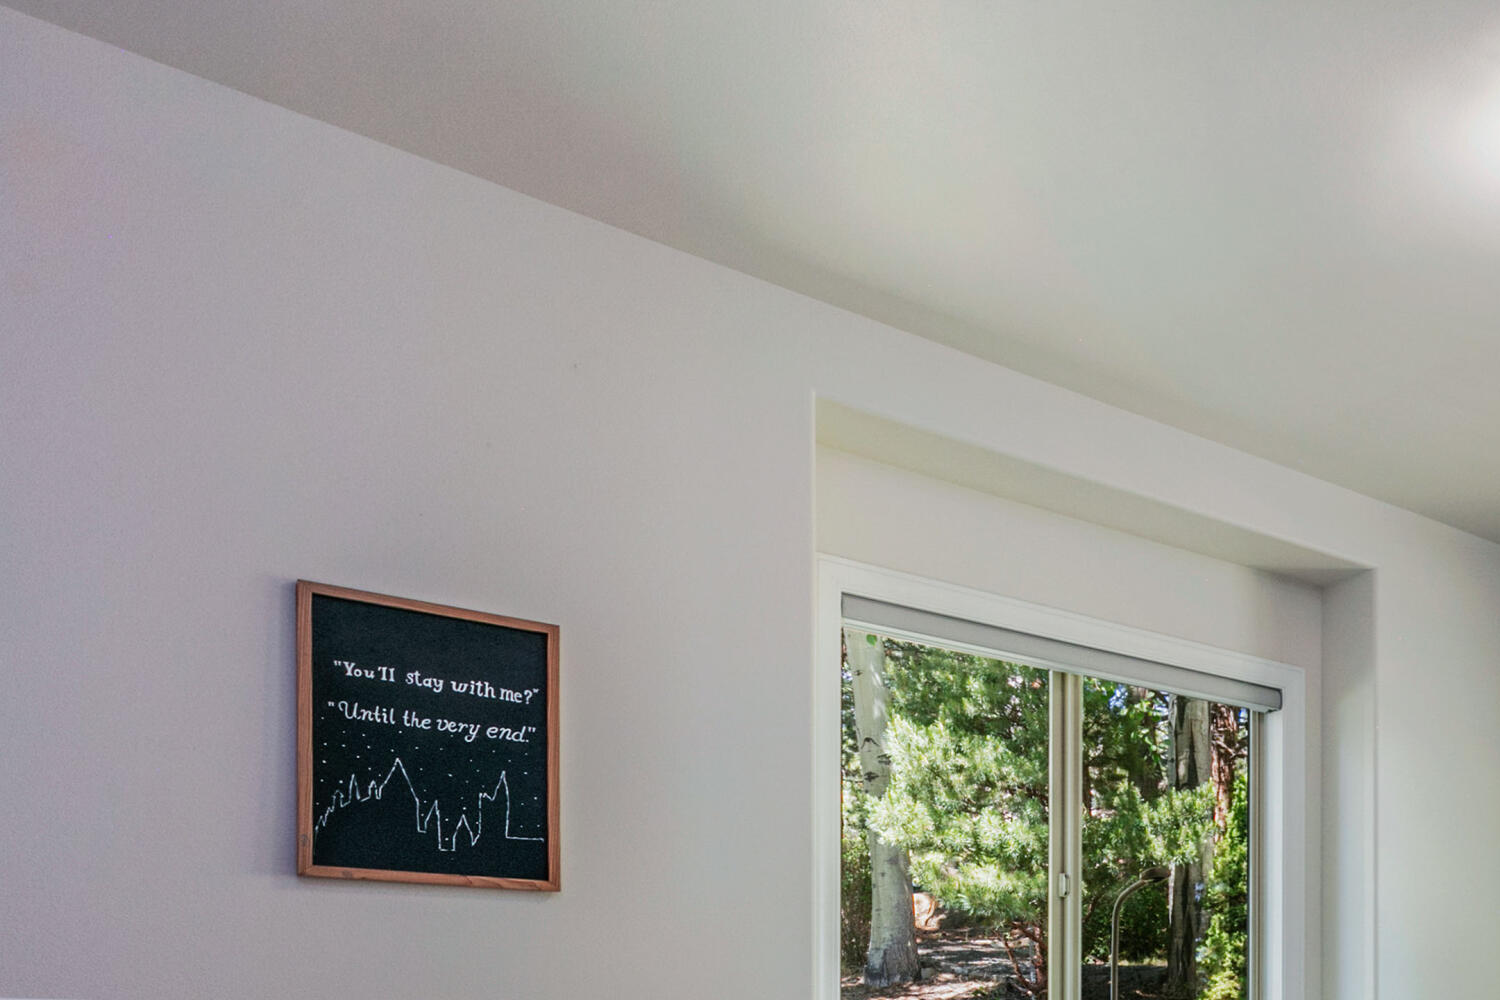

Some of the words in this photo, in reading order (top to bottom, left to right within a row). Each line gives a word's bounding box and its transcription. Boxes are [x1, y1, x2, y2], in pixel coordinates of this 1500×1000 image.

[405, 671, 445, 693] stay
[450, 681, 497, 699] with
[499, 688, 540, 705] me?"
[328, 701, 396, 725] "Until
[403, 710, 432, 730] the
[437, 719, 481, 743] very
[486, 726, 537, 743] end."
